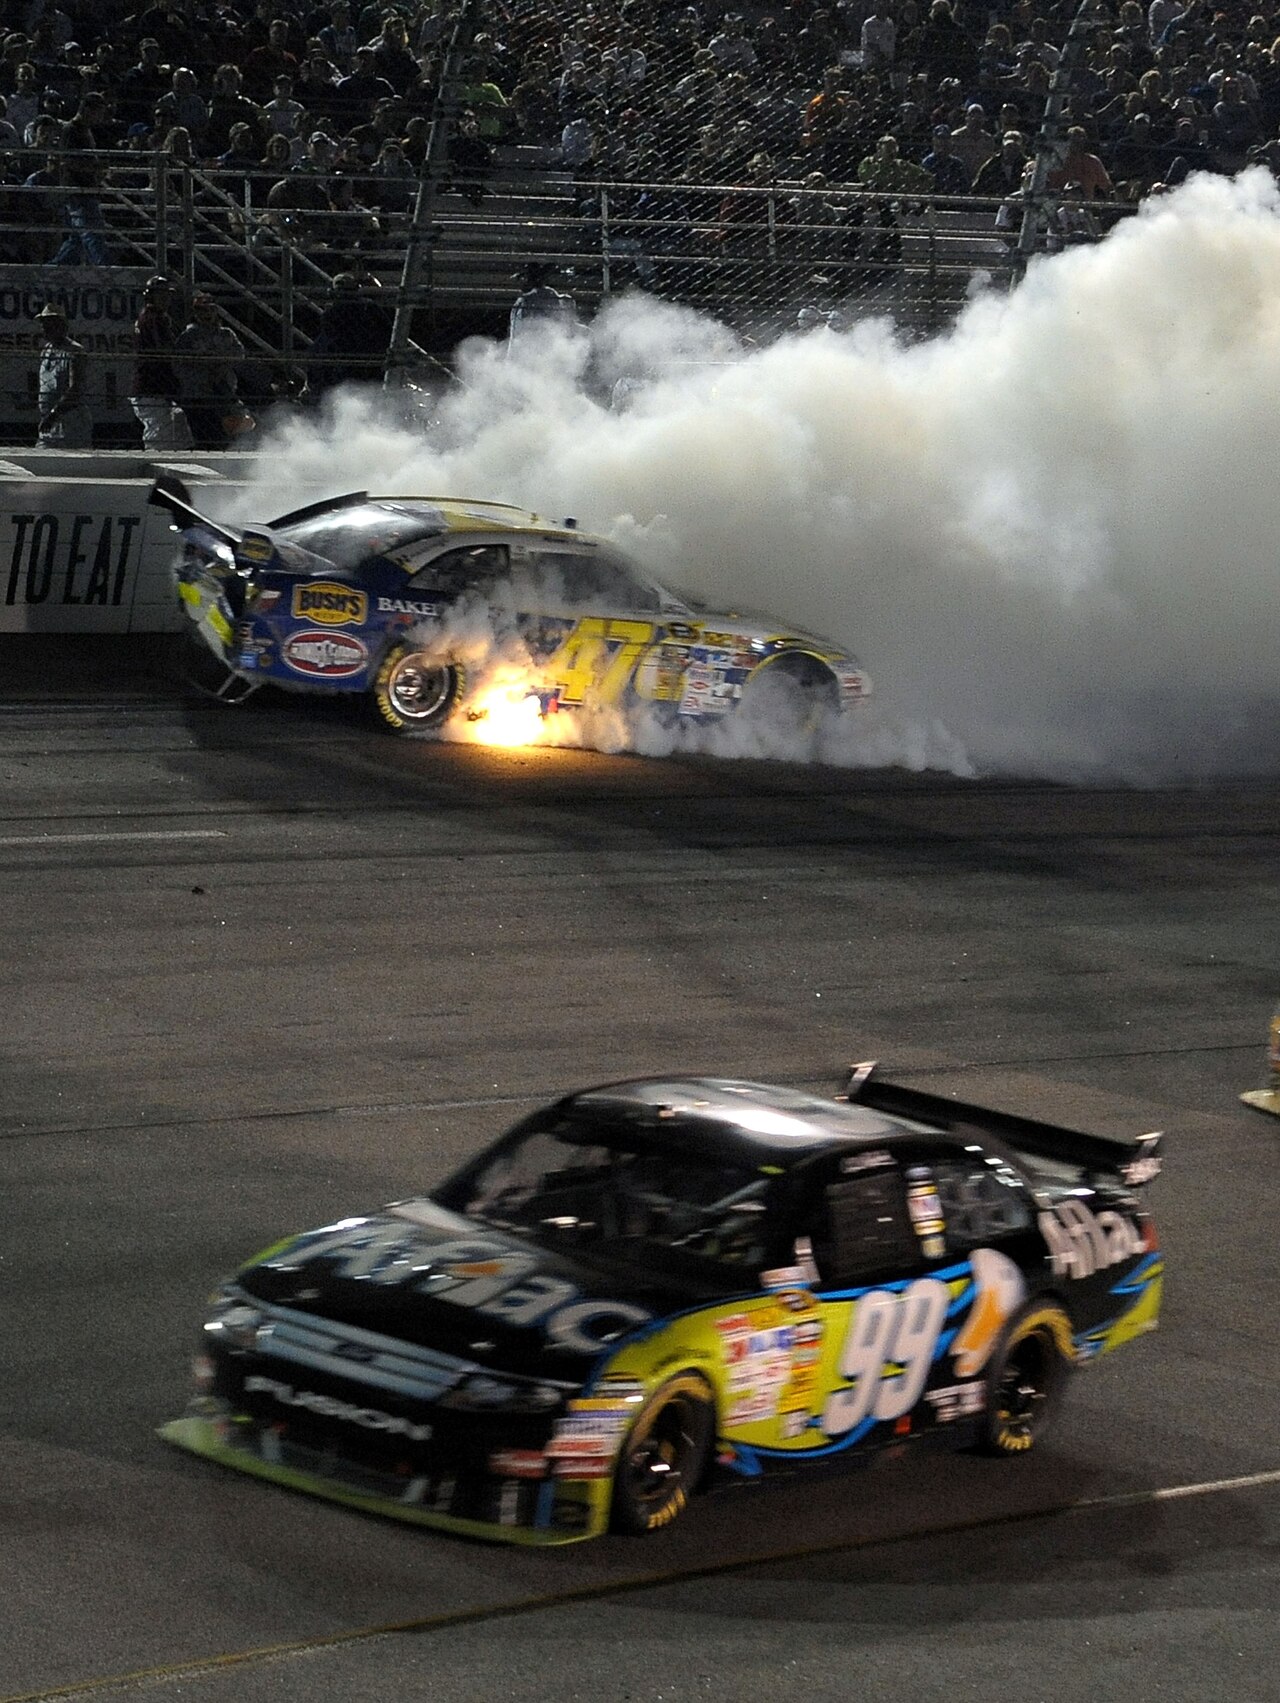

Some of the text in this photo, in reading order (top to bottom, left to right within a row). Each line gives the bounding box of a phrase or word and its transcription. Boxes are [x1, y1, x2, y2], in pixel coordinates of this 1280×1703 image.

[5, 514, 141, 606] TO EAT
[300, 589, 361, 617] BUSH'S
[819, 1278, 951, 1436] 99
